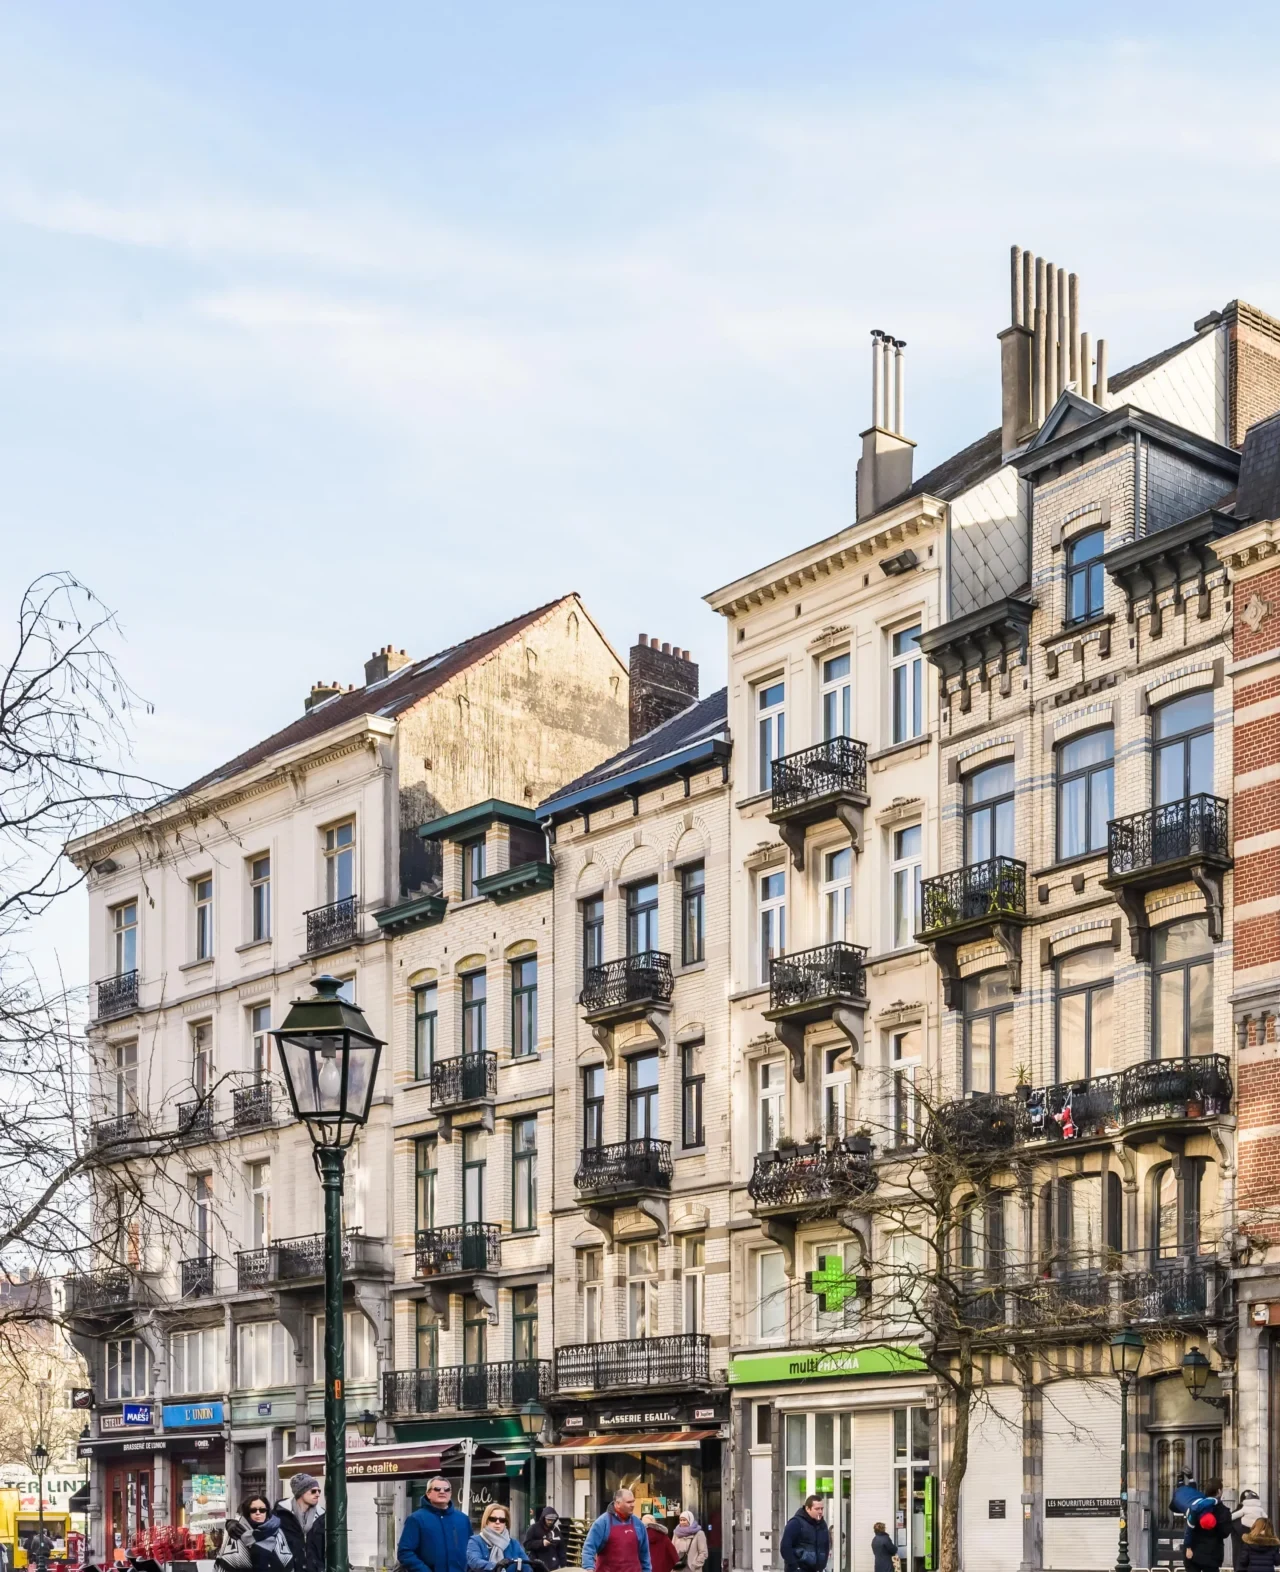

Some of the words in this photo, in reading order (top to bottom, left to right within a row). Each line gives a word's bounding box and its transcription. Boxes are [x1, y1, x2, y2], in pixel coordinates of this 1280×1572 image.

[127, 1413, 146, 1422] MAES
[192, 1407, 214, 1420] UNION
[123, 1442, 145, 1452] BRASSERIE
[366, 1461, 399, 1475] egalite
[1057, 1499, 1096, 1507] NOURRITURES
